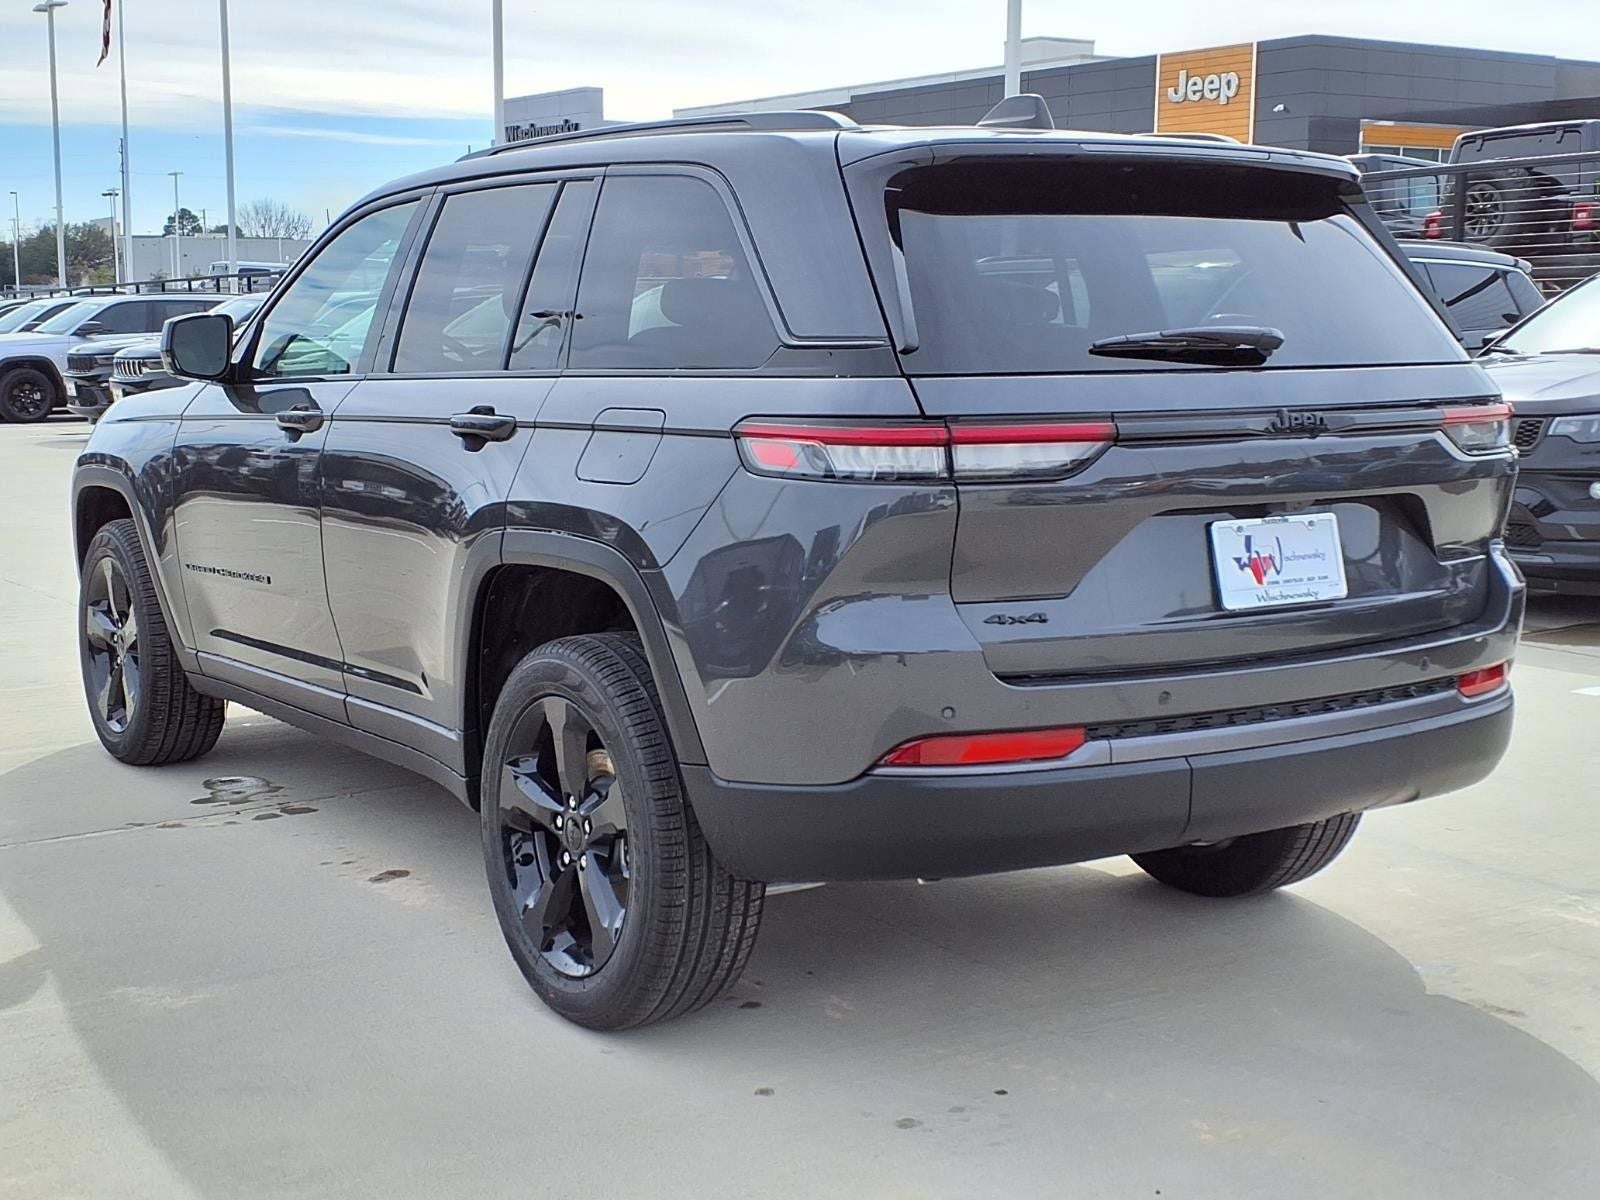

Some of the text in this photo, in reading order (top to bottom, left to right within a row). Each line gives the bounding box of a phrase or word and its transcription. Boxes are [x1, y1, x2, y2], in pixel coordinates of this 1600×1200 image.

[1167, 69, 1239, 105] Jeep
[1265, 408, 1328, 433] Jeep
[983, 612, 1048, 625] 4x4
